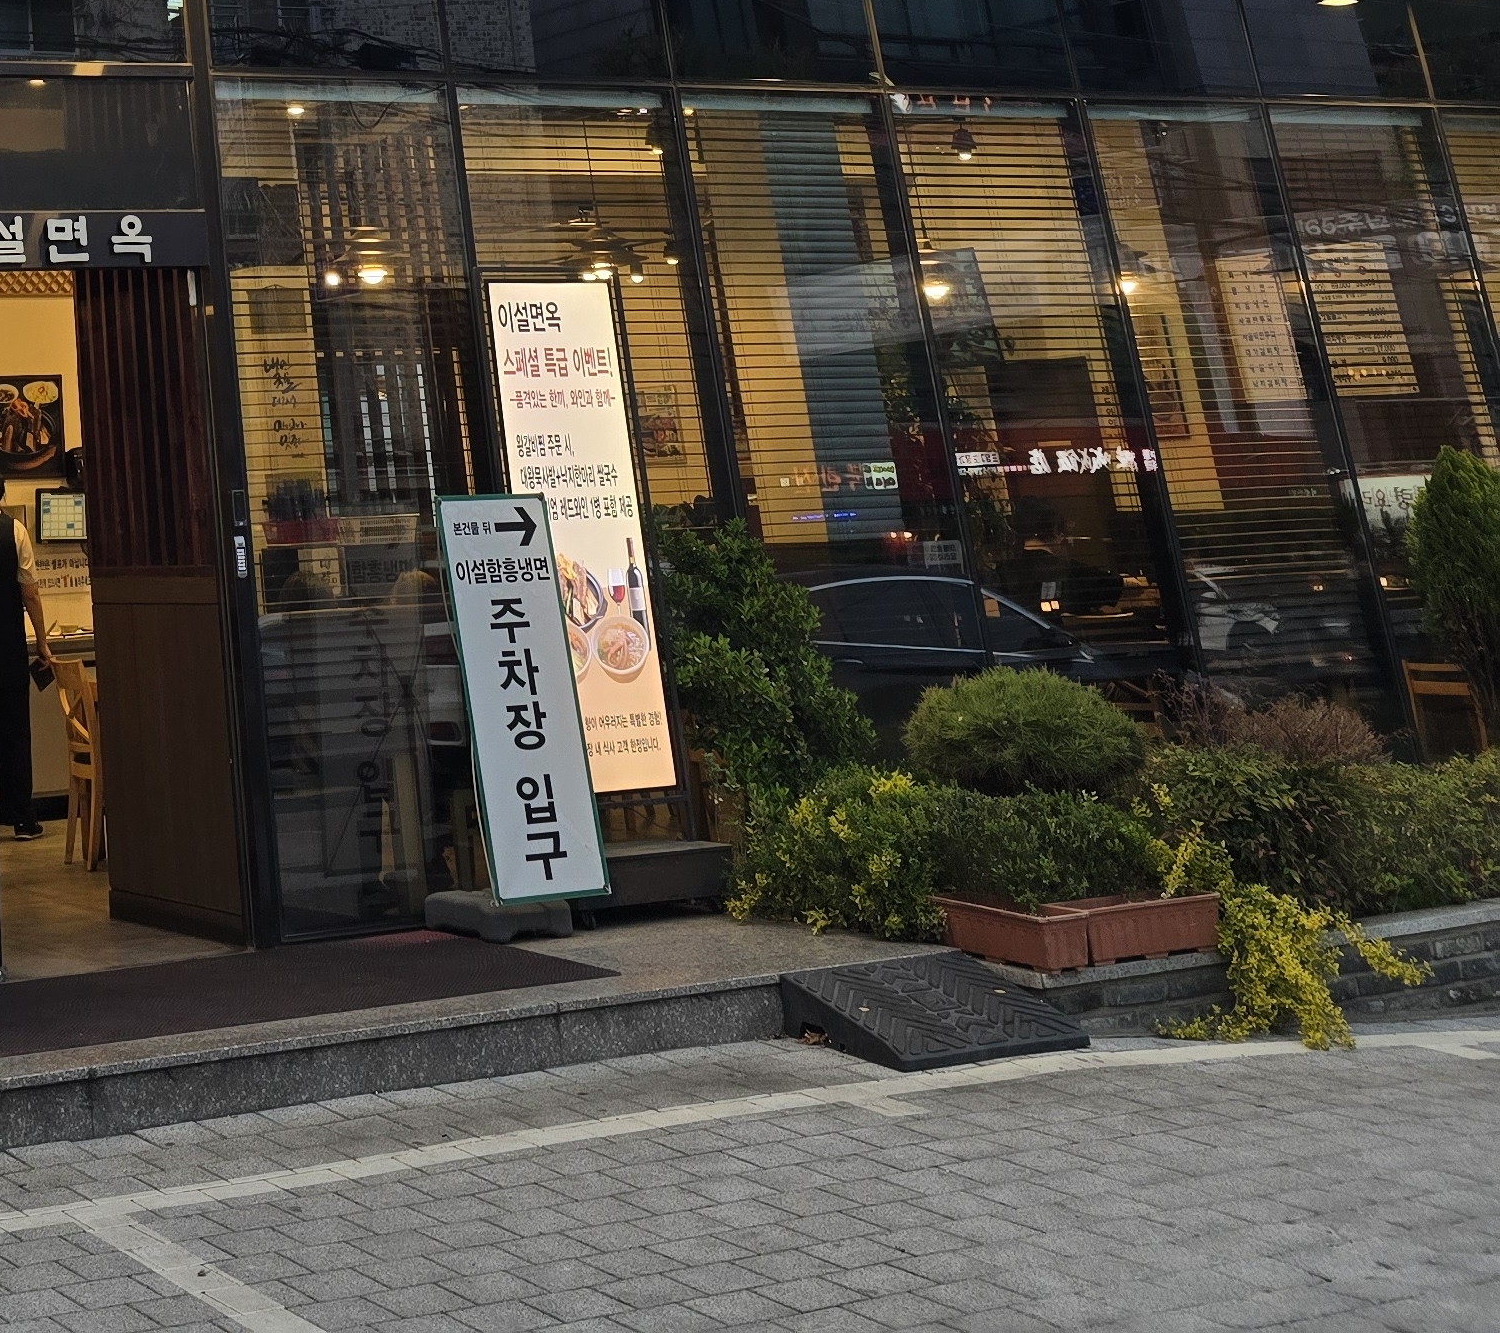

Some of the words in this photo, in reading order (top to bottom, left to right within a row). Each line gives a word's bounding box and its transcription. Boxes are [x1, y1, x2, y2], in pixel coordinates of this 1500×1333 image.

[498, 301, 562, 333] 이설면옥
[503, 347, 540, 379] 스페셜
[544, 347, 569, 378] 특급
[573, 346, 613, 378] 이벤트!
[570, 389, 593, 408] 와인과
[516, 434, 546, 458] 왕갈비찜
[547, 434, 562, 457] 주문
[597, 464, 619, 487] 쌀국수
[560, 496, 589, 520] 레드와인
[590, 496, 602, 519] 1병
[603, 495, 618, 518] 포함
[619, 495, 634, 518] 제공
[453, 522, 480, 536] 본건물
[482, 522, 491, 536] 뒤
[455, 557, 551, 586] 이설함흥냉면
[490, 598, 547, 751] 주차장
[629, 712, 647, 727] 특별한
[603, 740, 616, 755] 식사
[617, 739, 629, 754] 고객
[516, 773, 568, 881] 입구
